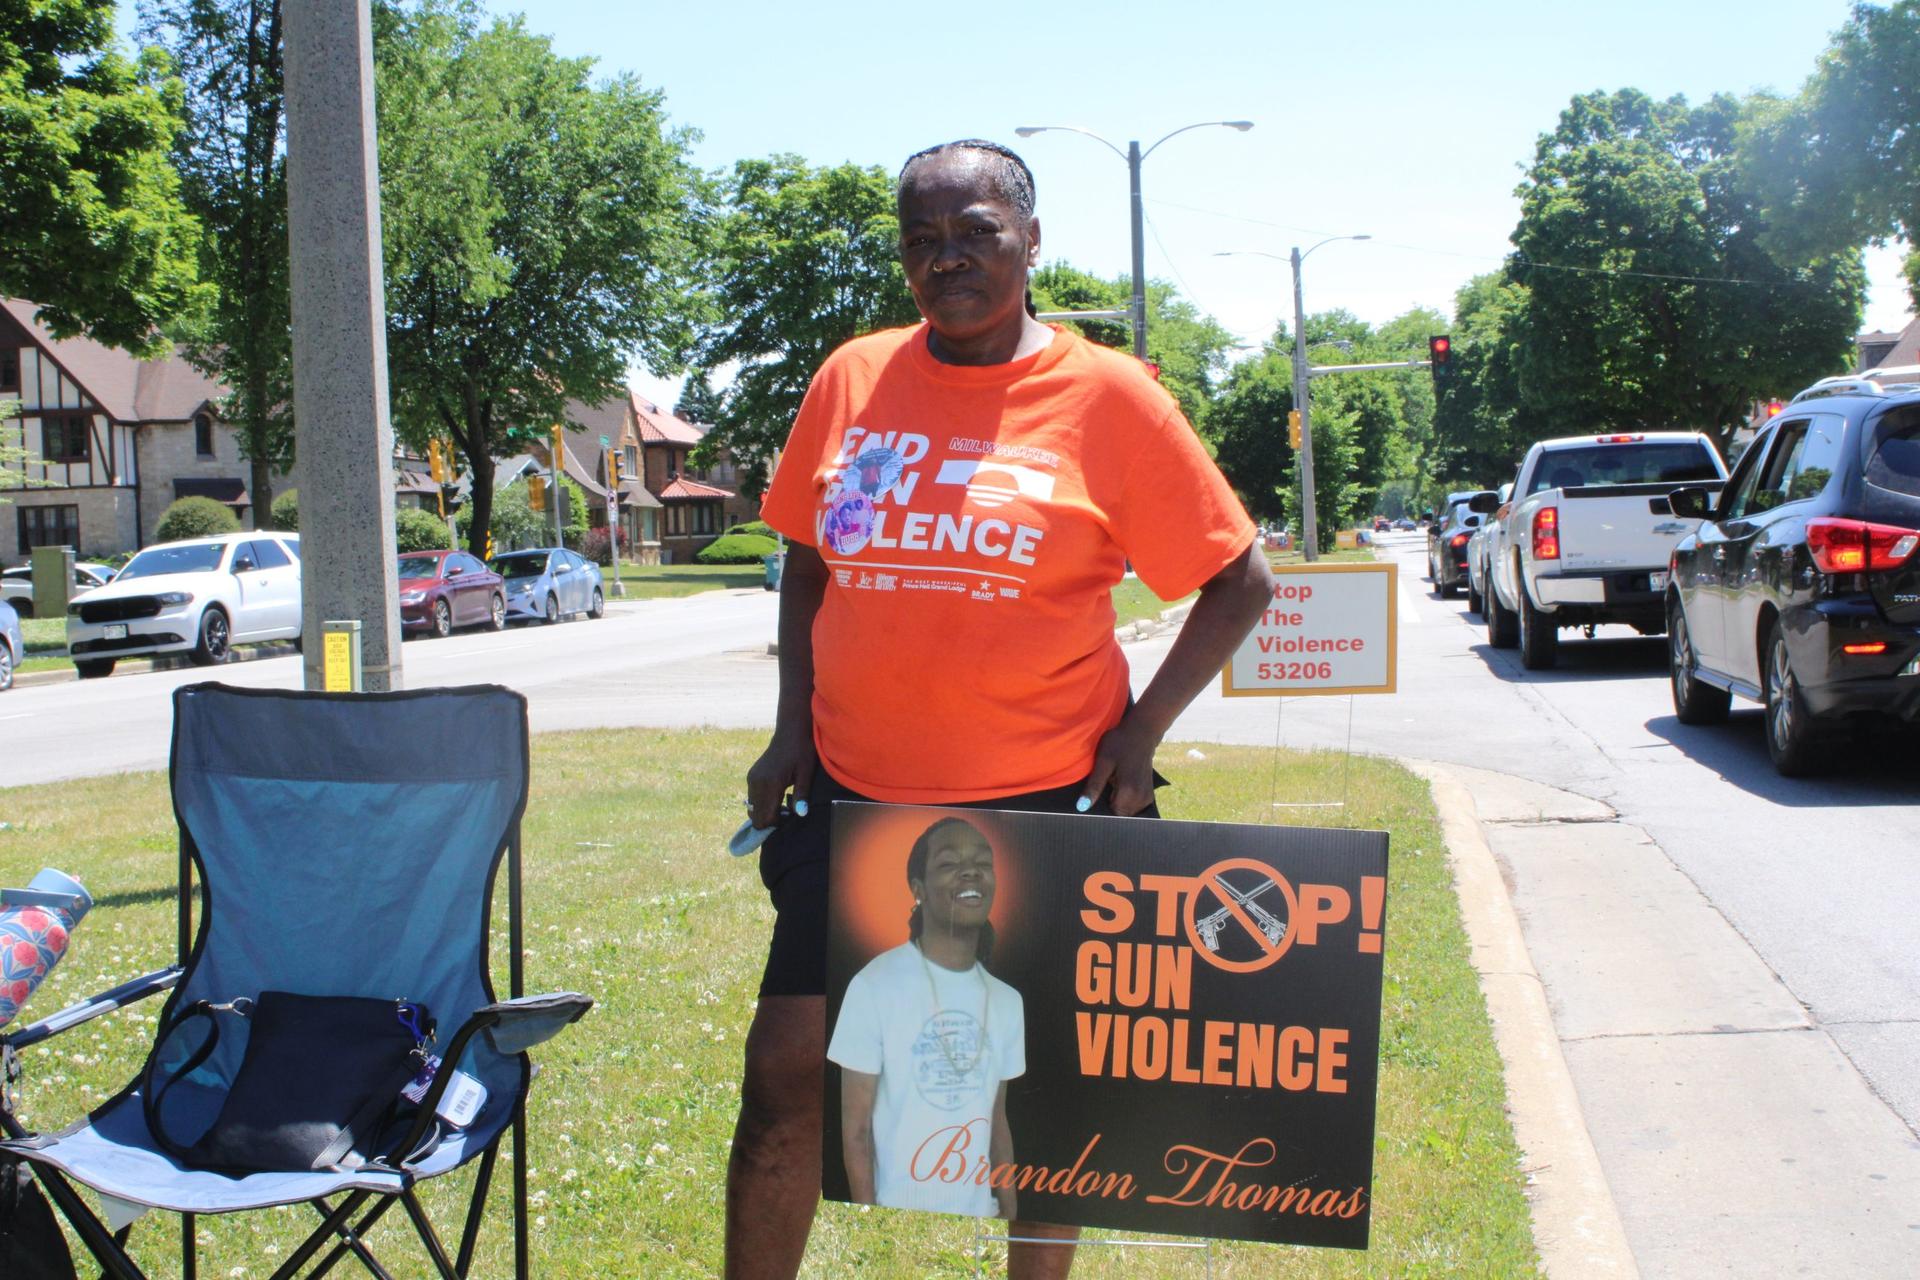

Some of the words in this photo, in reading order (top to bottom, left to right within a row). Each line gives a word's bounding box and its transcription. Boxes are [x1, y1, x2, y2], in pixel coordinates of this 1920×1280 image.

[832, 426, 930, 465] END
[948, 437, 1060, 469] MILWAUKEE
[823, 469, 920, 506] GN
[815, 509, 1044, 566] VLENCE
[972, 590, 995, 598] BRADY
[1274, 583, 1313, 603] top
[1260, 609, 1304, 626] The
[1257, 636, 1365, 653] Violence
[1257, 662, 1332, 680] 53206
[1075, 941, 1193, 1010] GUN
[1075, 1011, 1349, 1094] VIOLENCE
[910, 1118, 1136, 1200] Brandon
[1146, 1137, 1366, 1219] Thomas
